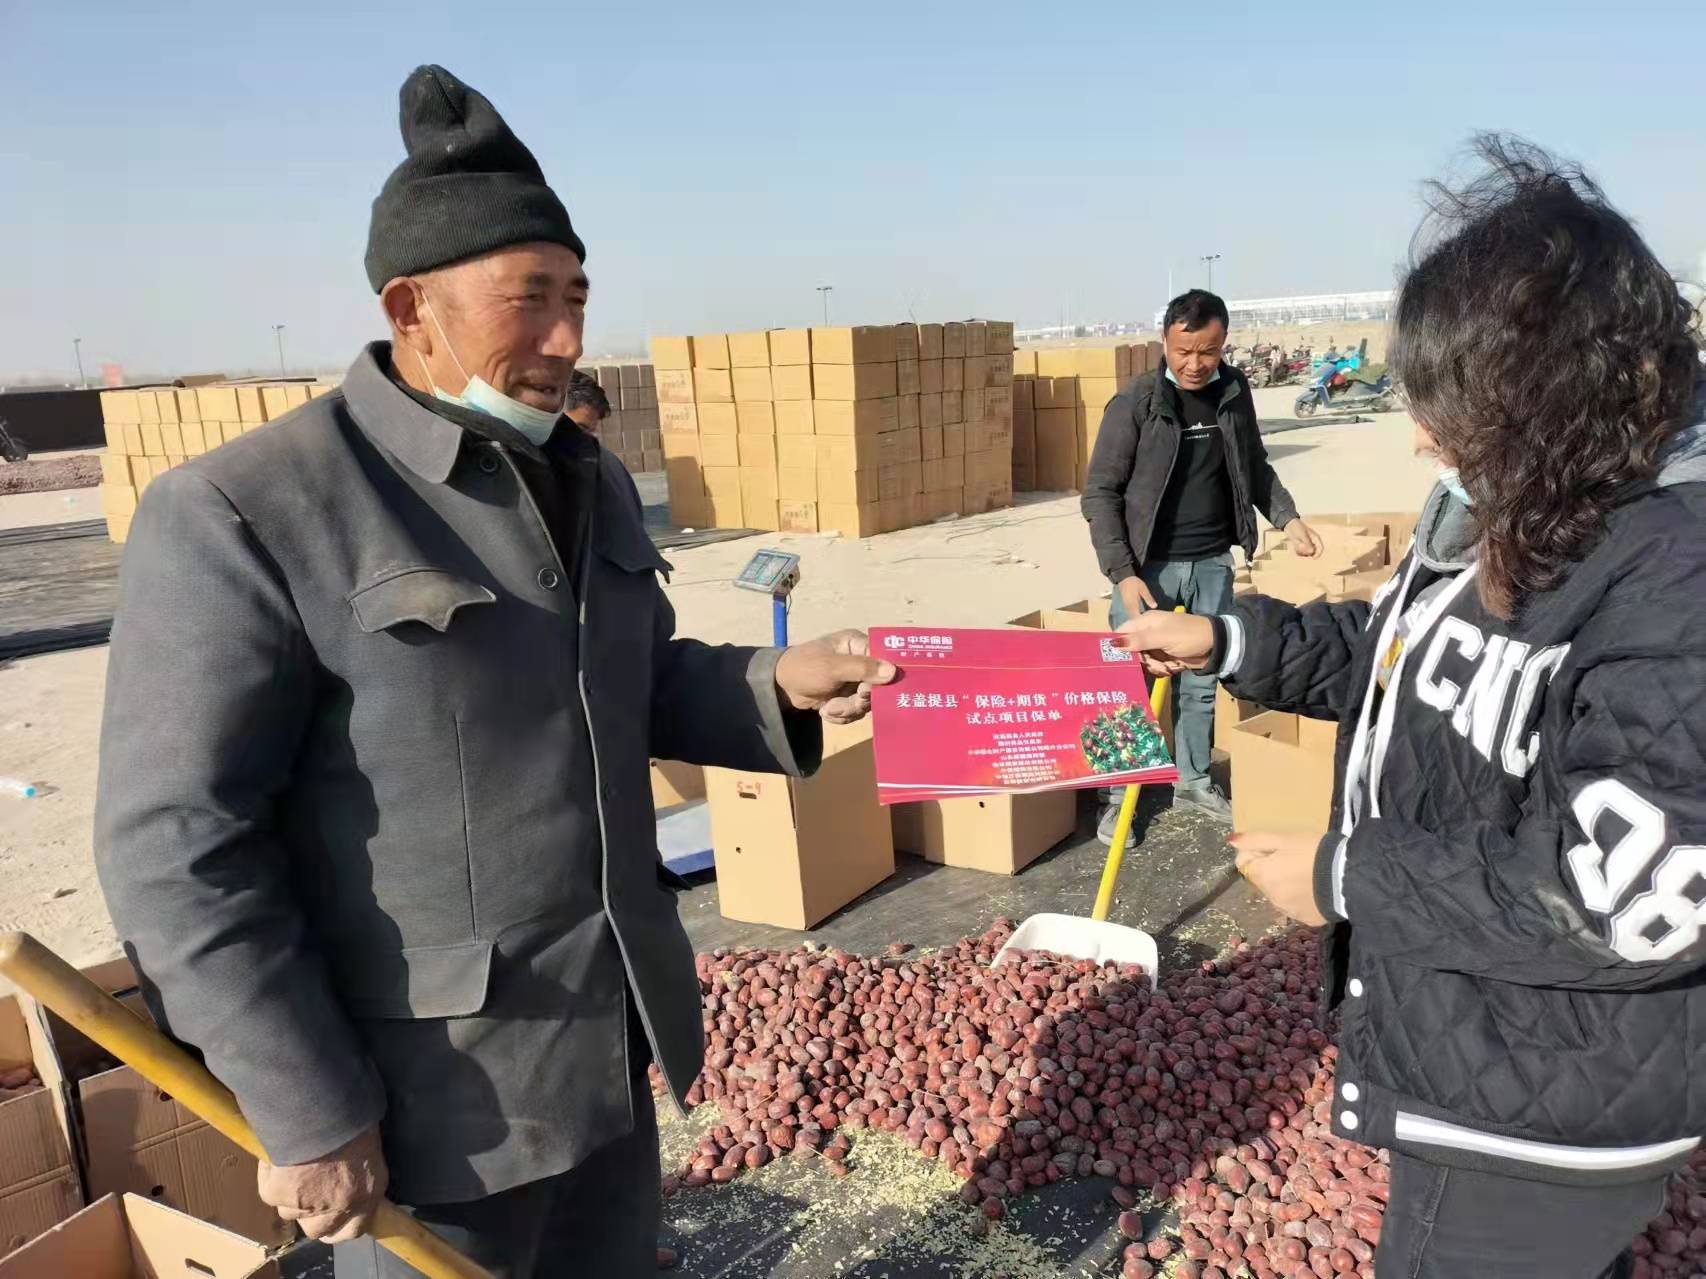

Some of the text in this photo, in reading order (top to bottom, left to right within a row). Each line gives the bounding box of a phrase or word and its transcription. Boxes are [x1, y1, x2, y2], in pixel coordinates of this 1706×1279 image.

[966, 710, 1062, 725] 试点项目保单
